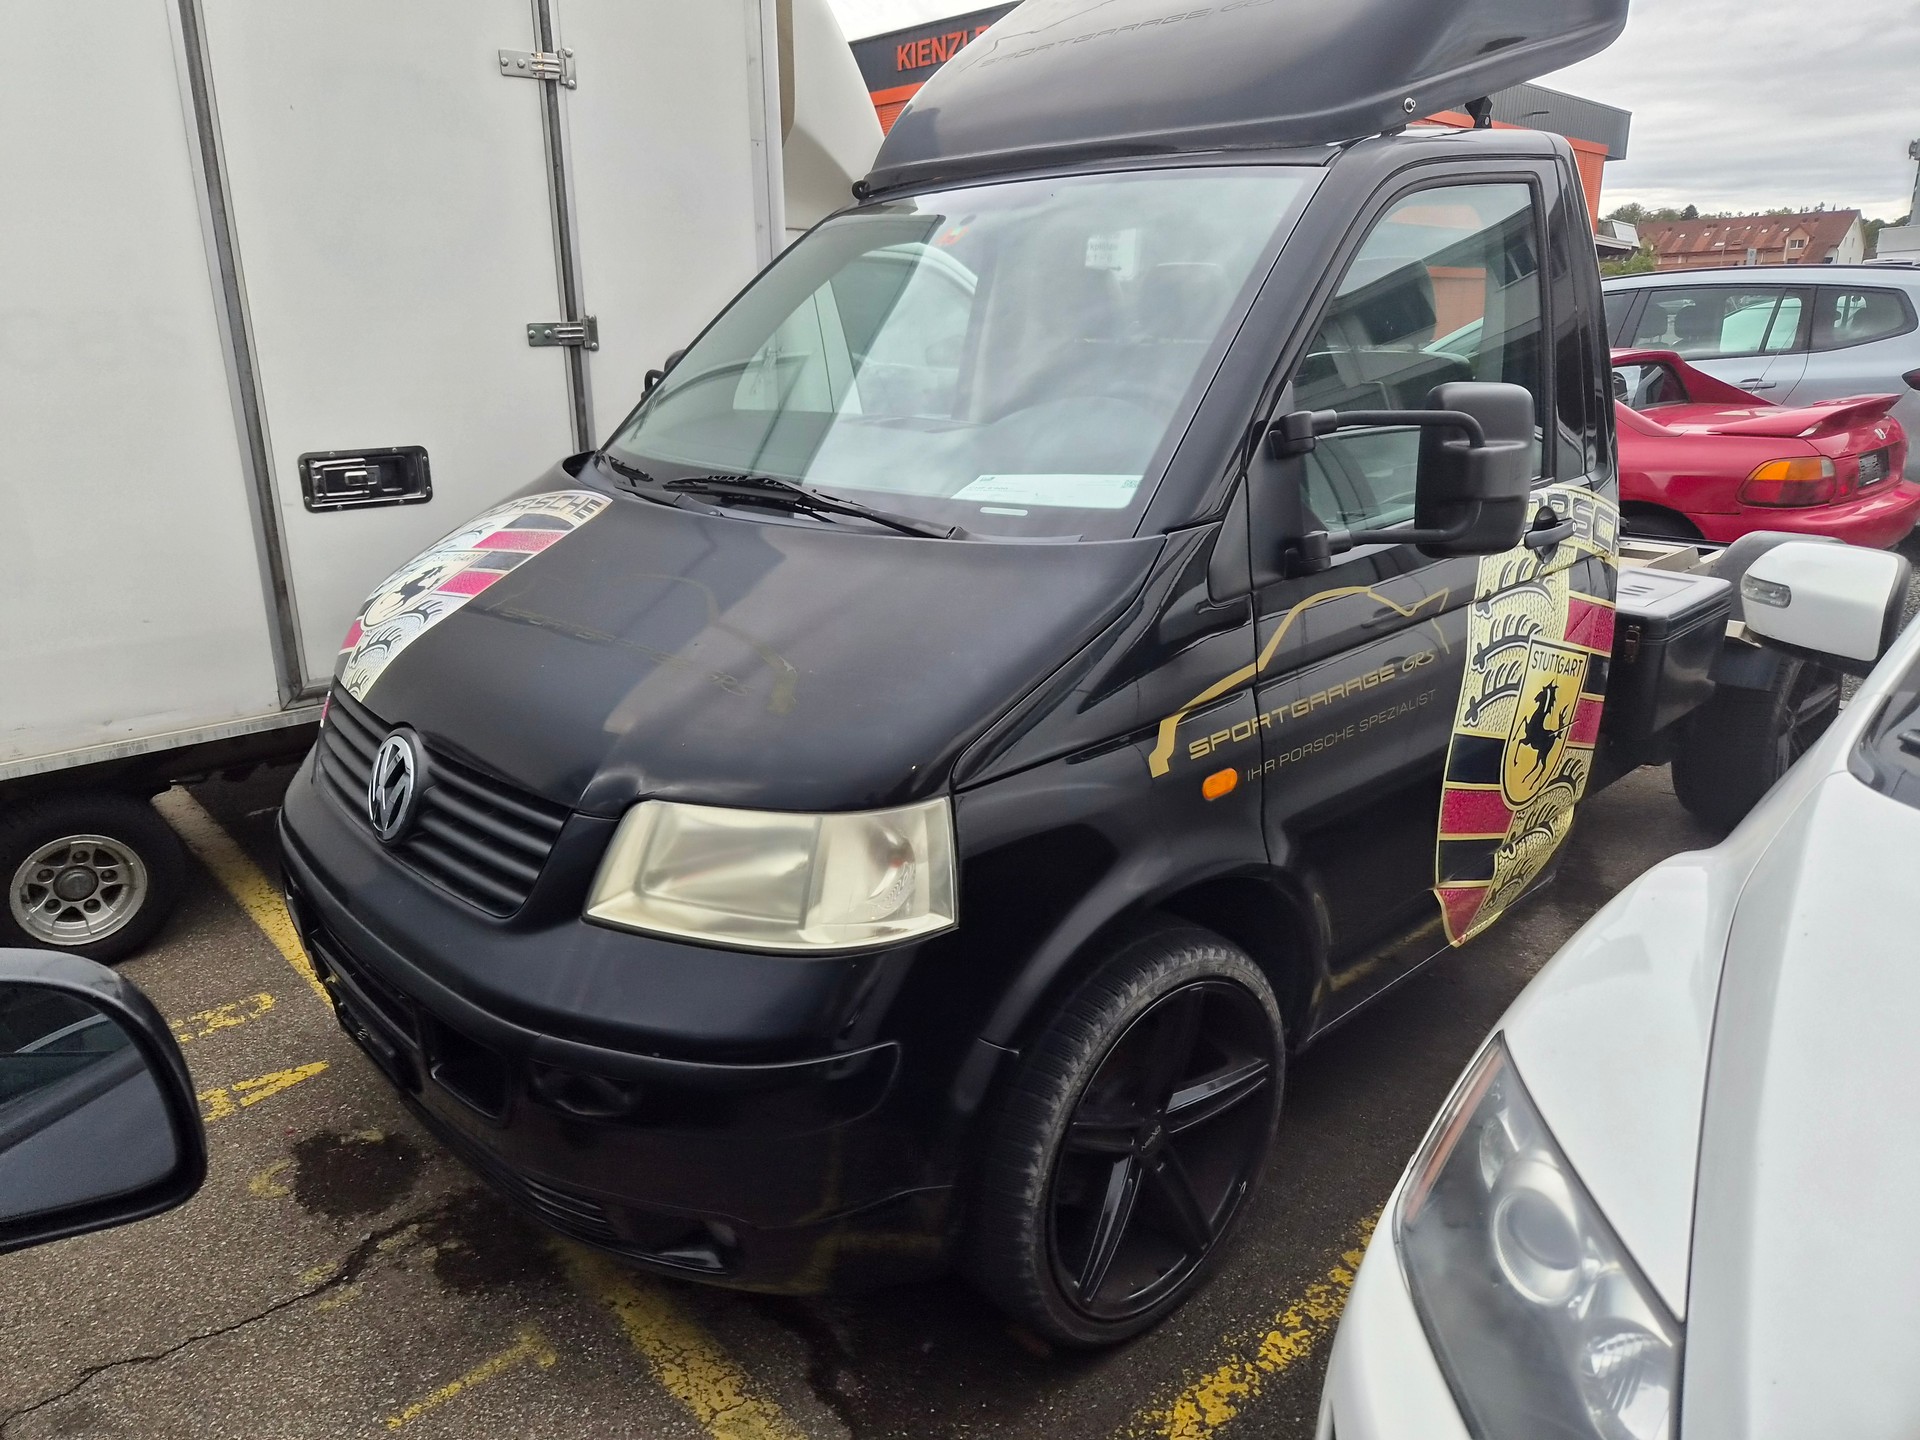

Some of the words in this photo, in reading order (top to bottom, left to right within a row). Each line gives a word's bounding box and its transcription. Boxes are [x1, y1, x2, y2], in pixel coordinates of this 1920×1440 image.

[1188, 664, 1396, 761] SPORTGARAGE
[1401, 650, 1436, 674] GRS
[1531, 650, 1584, 677] STUTTGART
[1247, 758, 1276, 782] IHR
[1279, 724, 1355, 767] PORSCHE
[1359, 688, 1437, 733] SPEZIALIST
